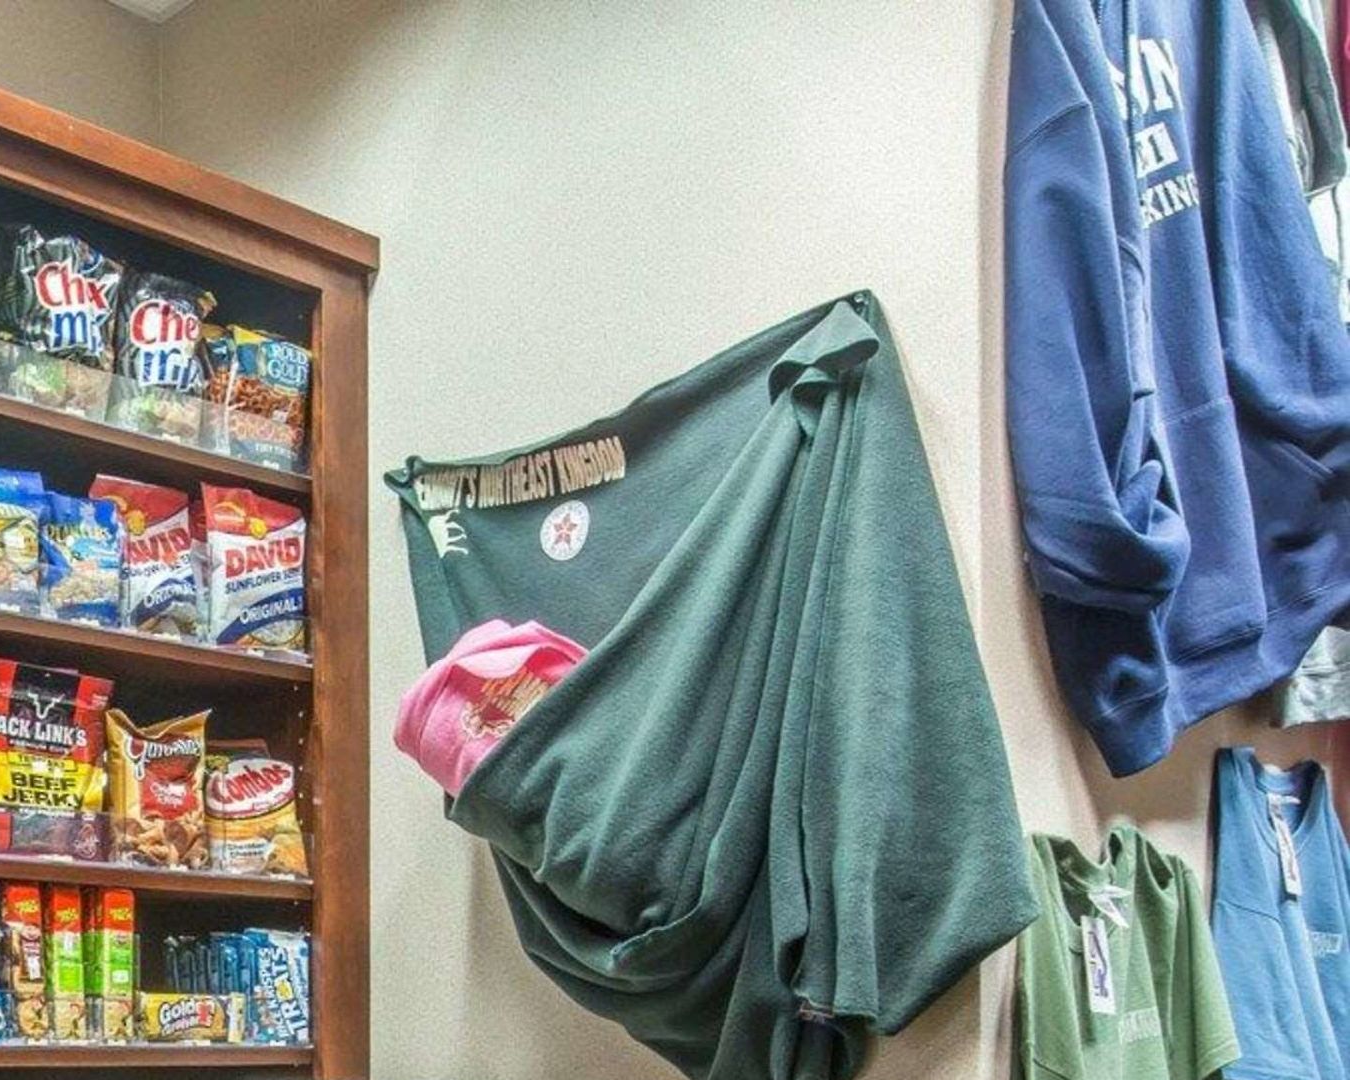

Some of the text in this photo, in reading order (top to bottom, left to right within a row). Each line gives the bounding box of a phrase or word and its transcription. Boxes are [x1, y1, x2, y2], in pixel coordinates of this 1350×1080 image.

[36, 260, 110, 309] Chx
[131, 301, 200, 345] Che
[224, 537, 302, 579] DAVID
[225, 573, 282, 595] SUNFLOWER
[239, 598, 299, 624] ORIGINAL
[35, 721, 88, 747] LINK'S
[11, 772, 77, 791] BEEF
[210, 763, 292, 805] Combos
[4, 789, 84, 809] JERKY
[271, 946, 308, 1035] TRATS
[159, 996, 216, 1026] Gold
